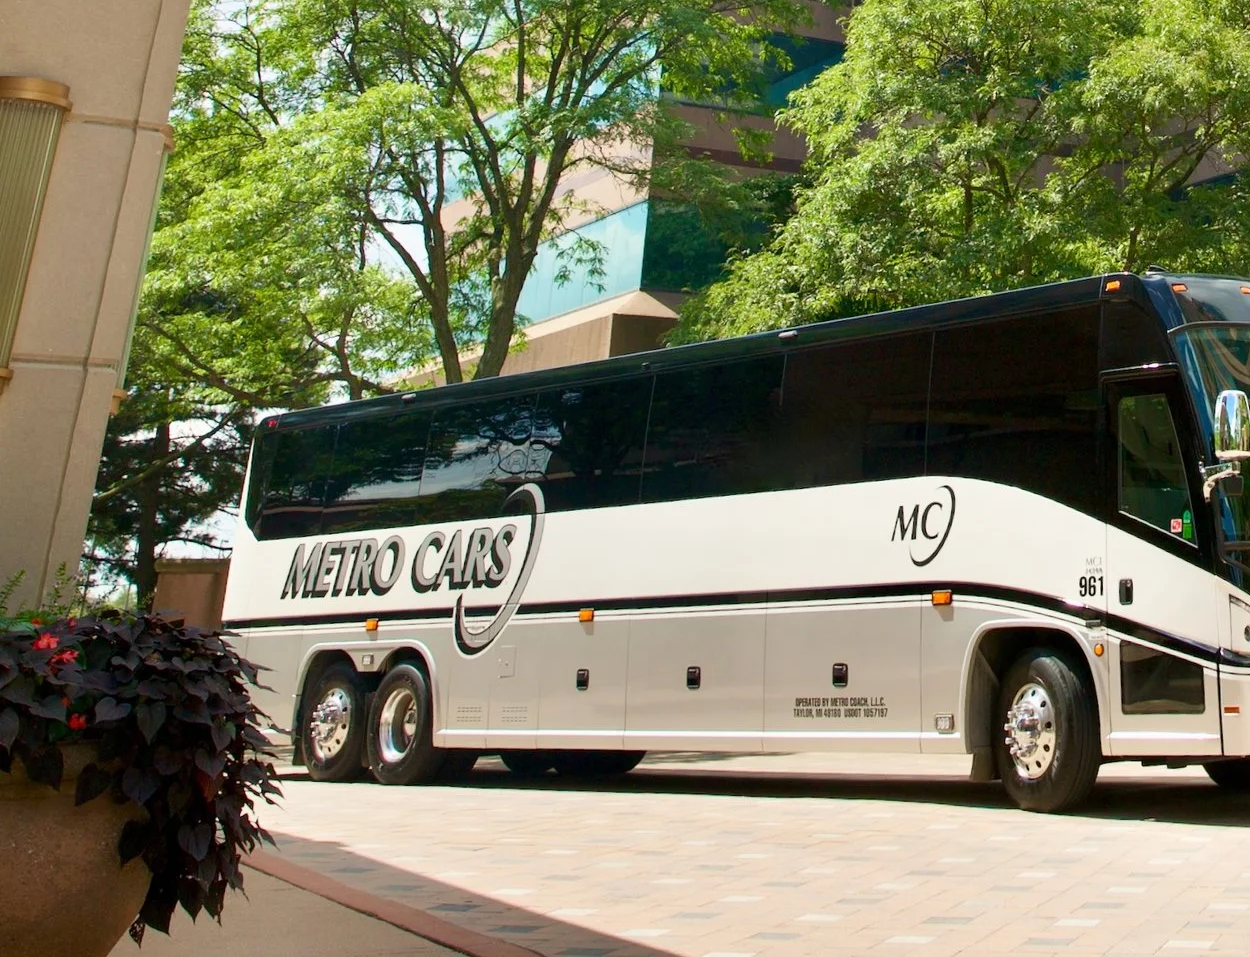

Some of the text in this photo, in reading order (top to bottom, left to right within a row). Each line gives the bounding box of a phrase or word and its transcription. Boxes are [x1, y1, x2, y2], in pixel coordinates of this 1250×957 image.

[891, 502, 943, 542] MC
[280, 524, 518, 600] METRO CARS
[1079, 575, 1104, 597] 961
[793, 708, 814, 718] TAYLOR,
[815, 708, 823, 718] MI
[795, 697, 821, 707] OPERATED
[822, 697, 829, 707] BY
[830, 697, 849, 707] METRO
